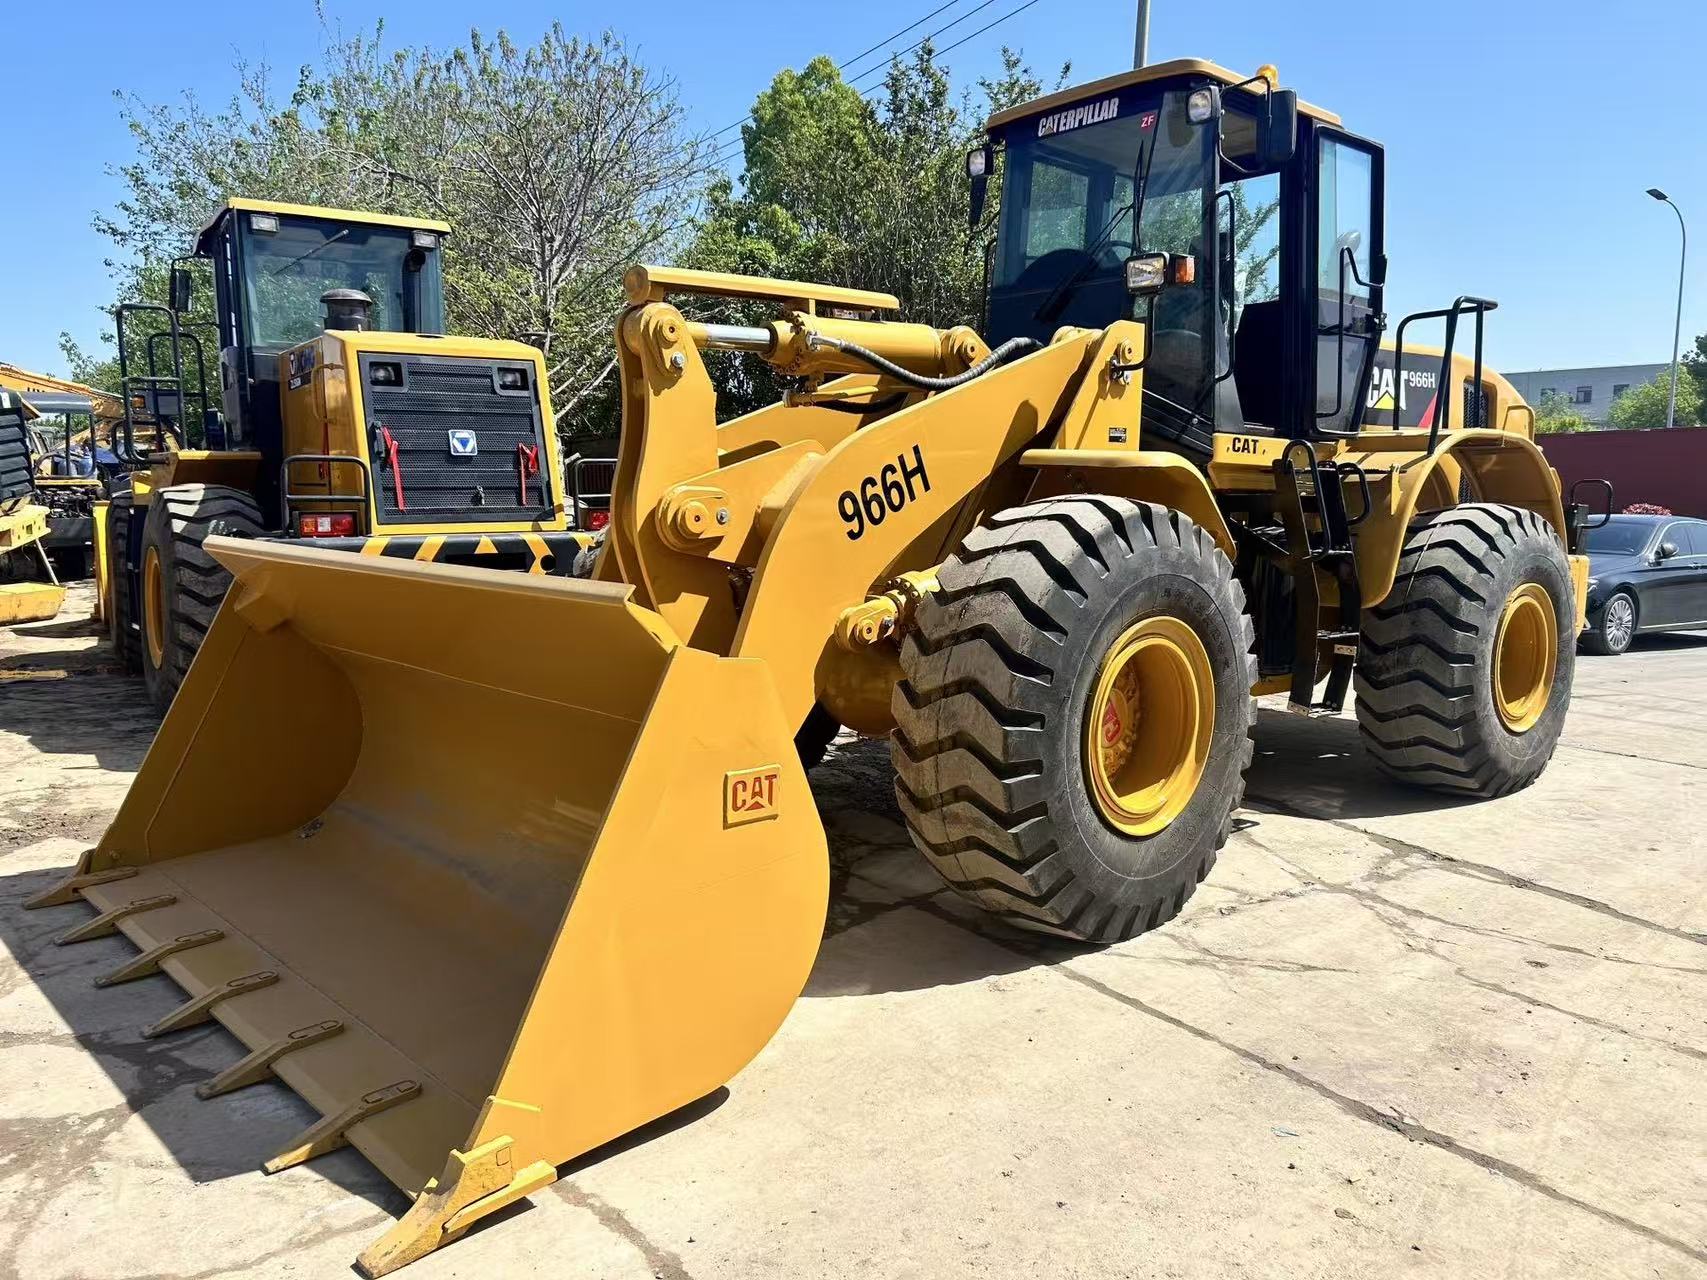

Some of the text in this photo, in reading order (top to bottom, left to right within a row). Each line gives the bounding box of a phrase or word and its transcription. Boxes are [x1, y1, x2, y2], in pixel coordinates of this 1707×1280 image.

[1038, 98, 1119, 137] CATERPILLAR
[1141, 115, 1154, 128] ZF
[1366, 366, 1436, 411] CAT 966H
[1231, 437, 1259, 455] CAT
[838, 444, 931, 541] 966H
[732, 774, 777, 812] CAT
